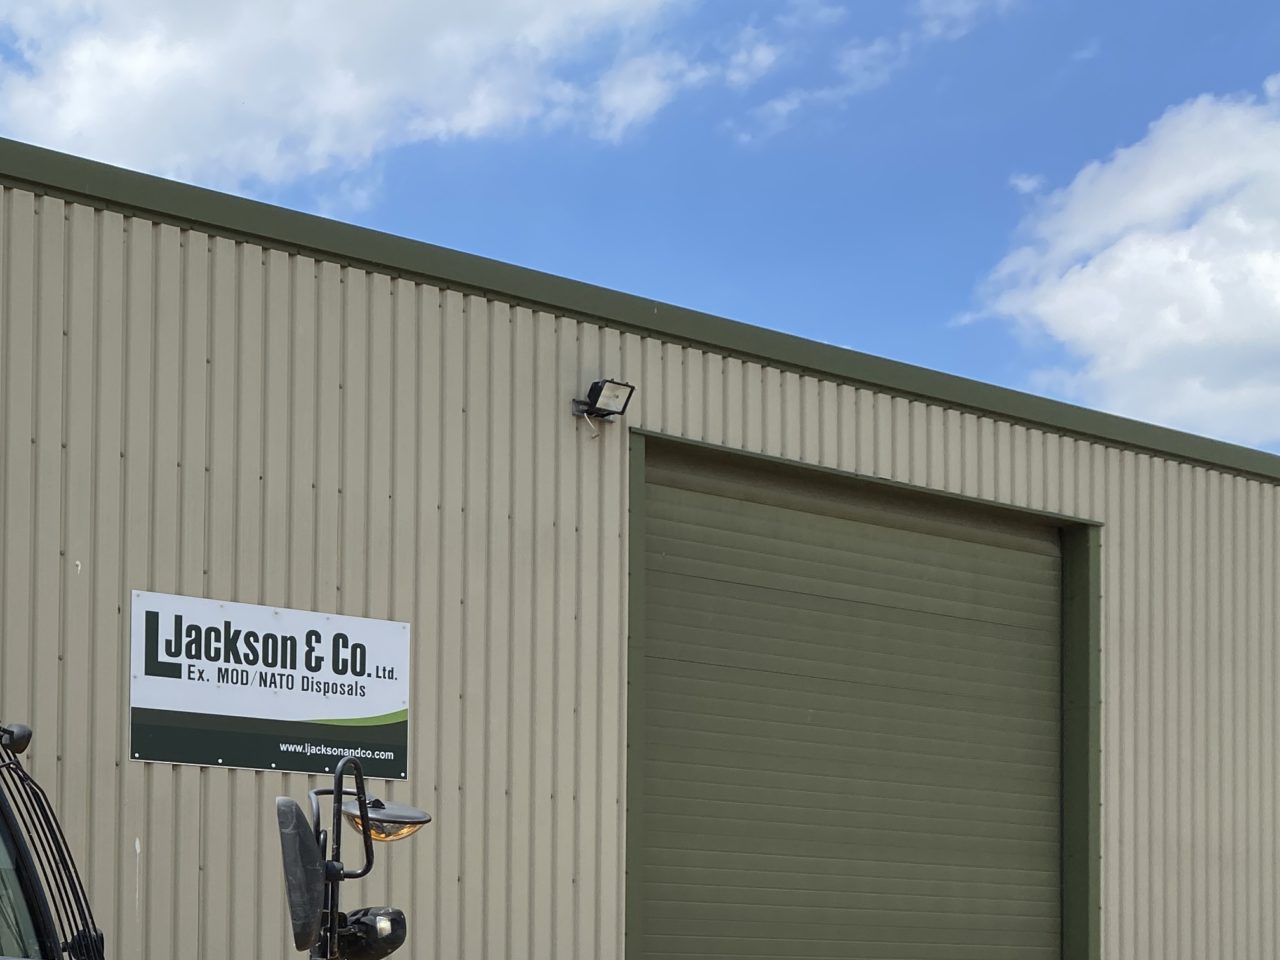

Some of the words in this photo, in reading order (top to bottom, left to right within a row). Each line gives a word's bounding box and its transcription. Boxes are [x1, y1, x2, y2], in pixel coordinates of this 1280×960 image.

[304, 629, 324, 673] &
[331, 632, 371, 678] Co.
[375, 665, 398, 681] Ltd.
[187, 664, 210, 682] Ex.
[217, 667, 294, 690] MOD/NATO
[301, 676, 366, 698] Disposals
[279, 742, 394, 760] www.ljacksonandco.com
